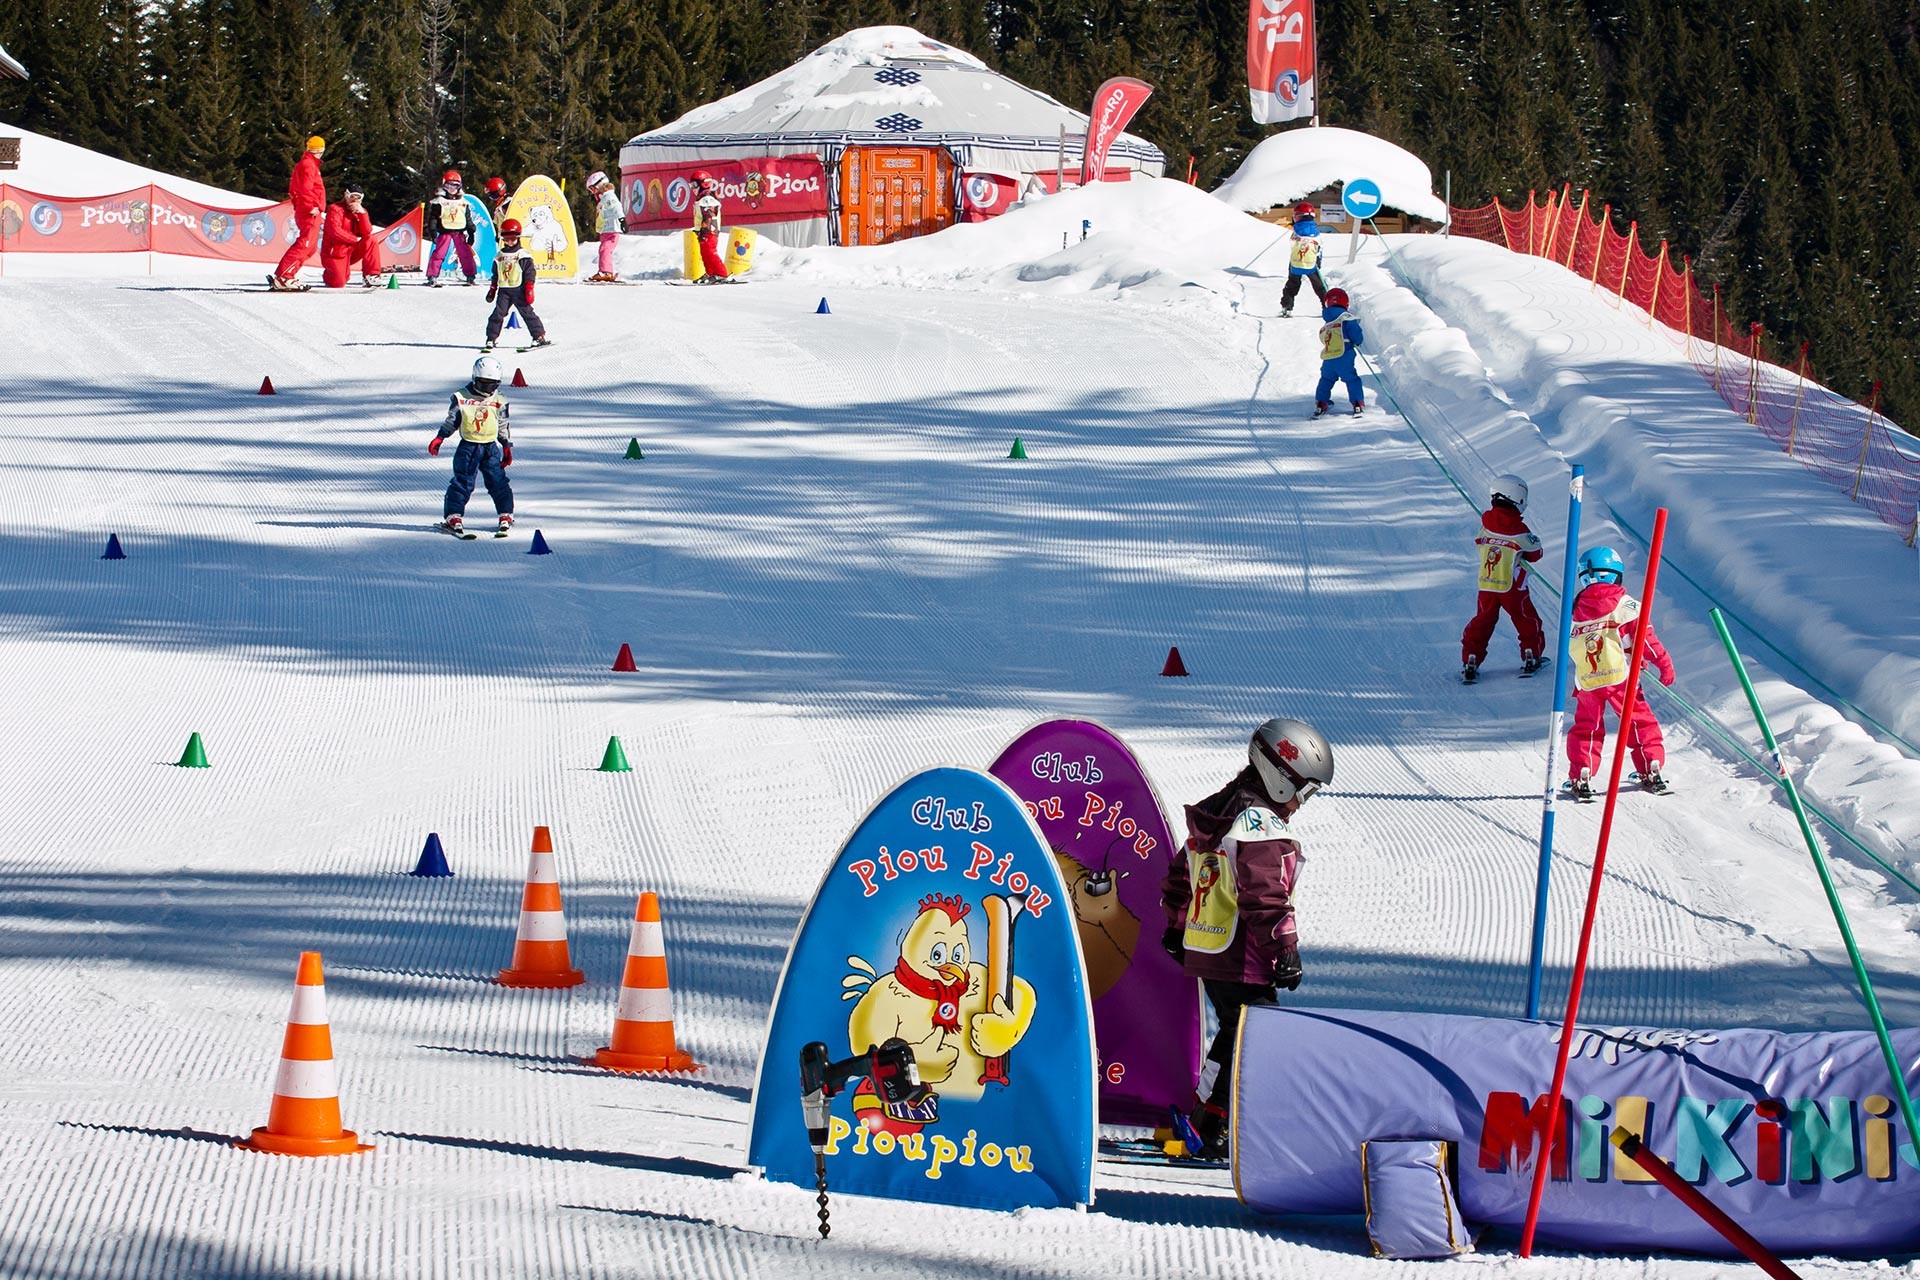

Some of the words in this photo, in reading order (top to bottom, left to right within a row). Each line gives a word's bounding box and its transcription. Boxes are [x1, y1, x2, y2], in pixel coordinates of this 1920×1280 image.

[517, 195, 539, 208] Piou
[543, 194, 564, 210] Piou
[528, 185, 548, 193] Club
[766, 173, 820, 198] Piou
[80, 205, 131, 228] Piou
[151, 203, 198, 229] Piou
[534, 263, 566, 271] urson
[1031, 752, 1104, 785] Club
[911, 797, 993, 834] Club
[1023, 795, 1064, 820] ou
[1078, 791, 1158, 859] Piou
[847, 844, 947, 897] Piou
[963, 841, 1053, 919] Piou
[824, 1115, 1034, 1179] Pioupiou
[1478, 1091, 1920, 1186] MiLKiNi
